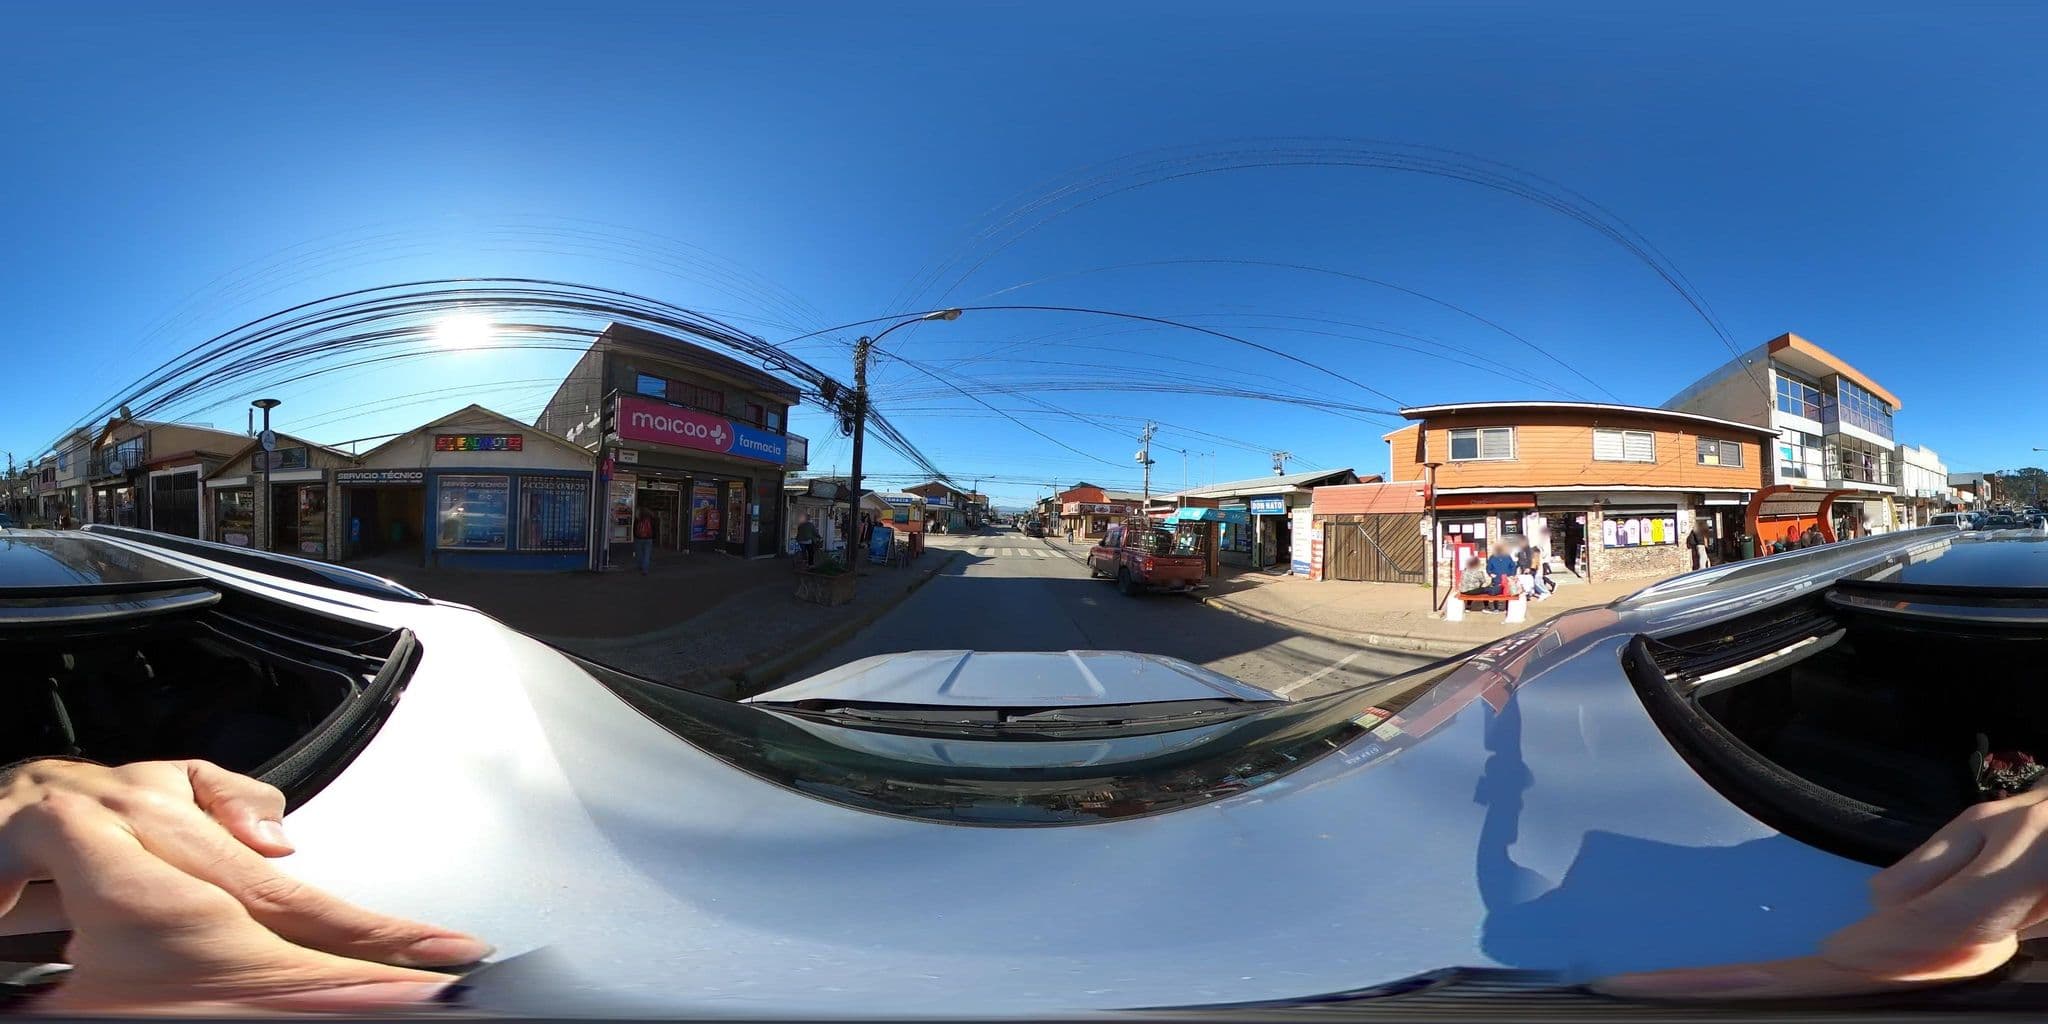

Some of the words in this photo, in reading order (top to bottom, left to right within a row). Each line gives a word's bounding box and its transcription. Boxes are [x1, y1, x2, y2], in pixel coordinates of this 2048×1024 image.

[632, 412, 708, 439] maicao
[739, 434, 782, 456] farmacia
[337, 472, 379, 480] SERVICIO
